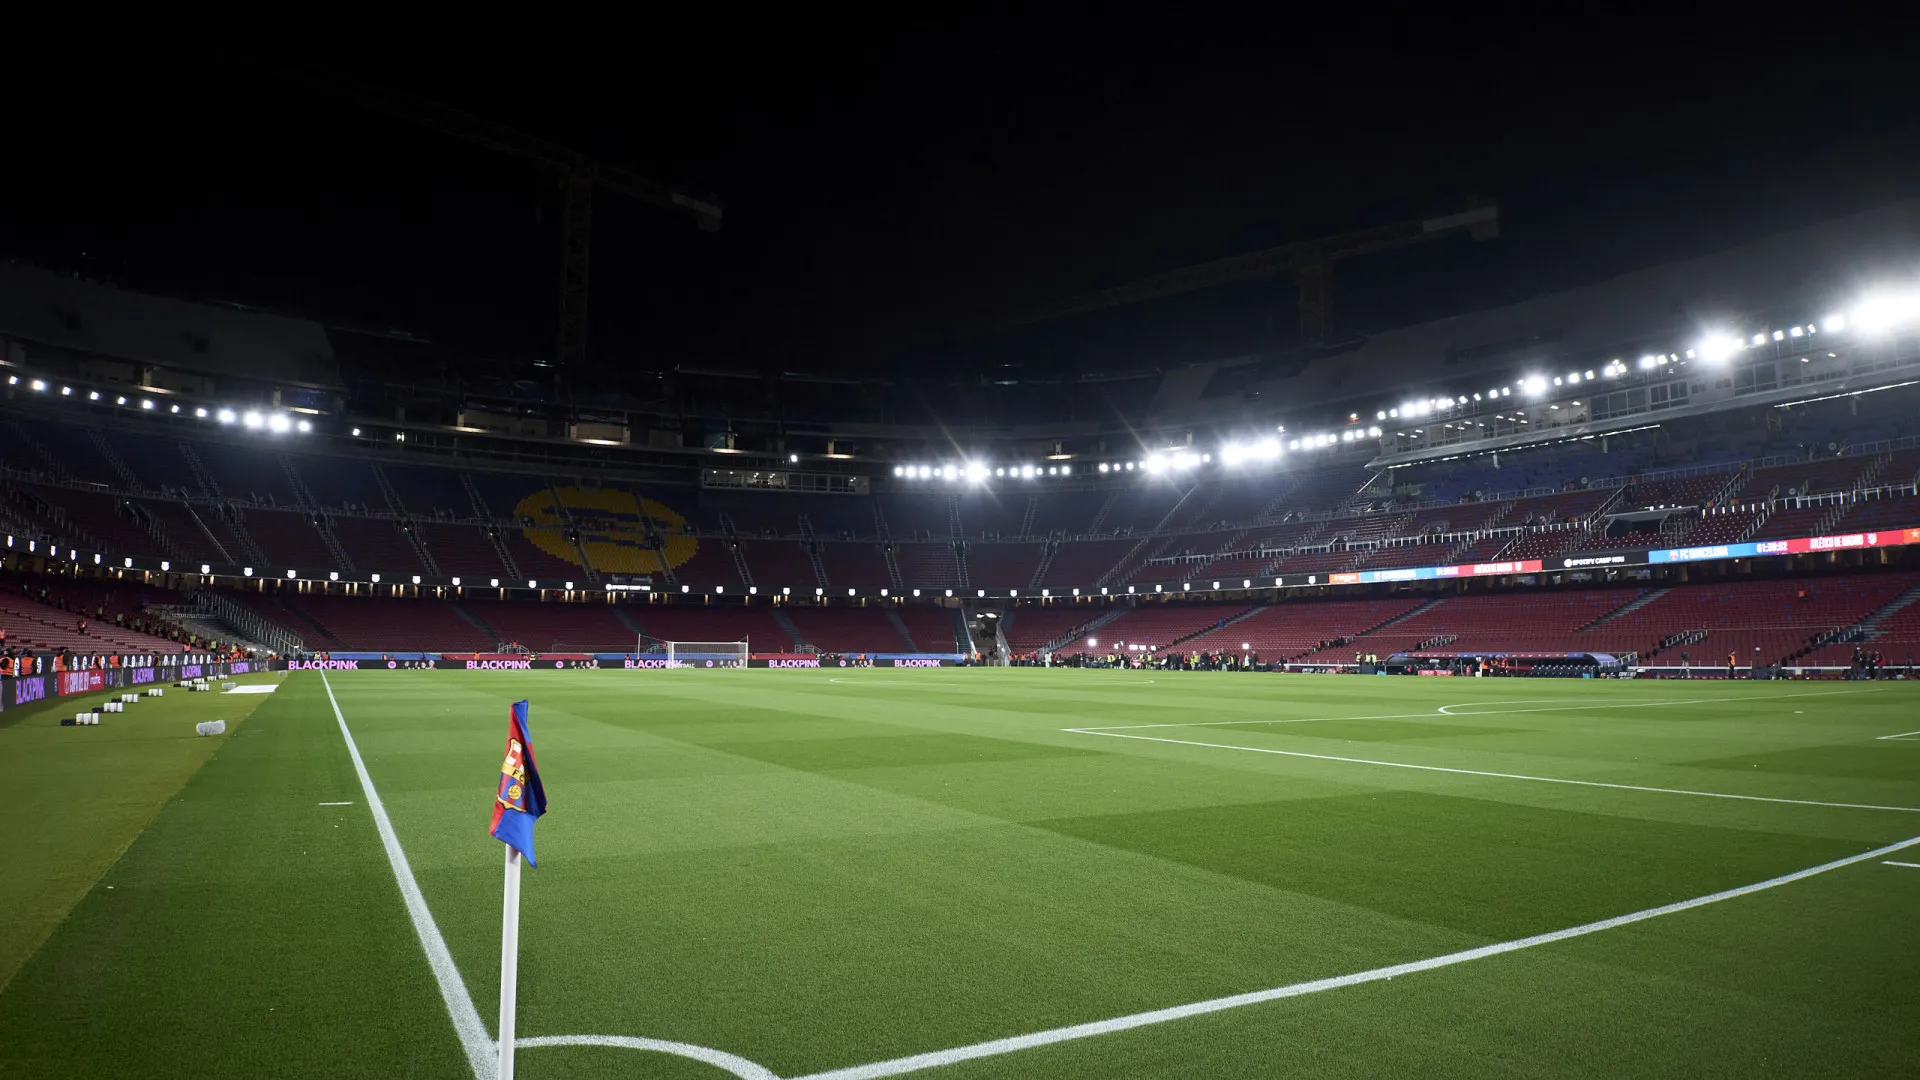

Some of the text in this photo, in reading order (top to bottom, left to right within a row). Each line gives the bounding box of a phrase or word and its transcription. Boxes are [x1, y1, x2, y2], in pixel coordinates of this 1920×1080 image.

[1680, 546, 1728, 559] FC BARCELONA
[1572, 558, 1595, 566] SPOTIFY
[288, 660, 358, 670] BLACKPINK
[466, 660, 531, 670] BLACKPINK
[768, 659, 820, 668] BLACKPINK
[894, 659, 941, 668] BLACKPINK
